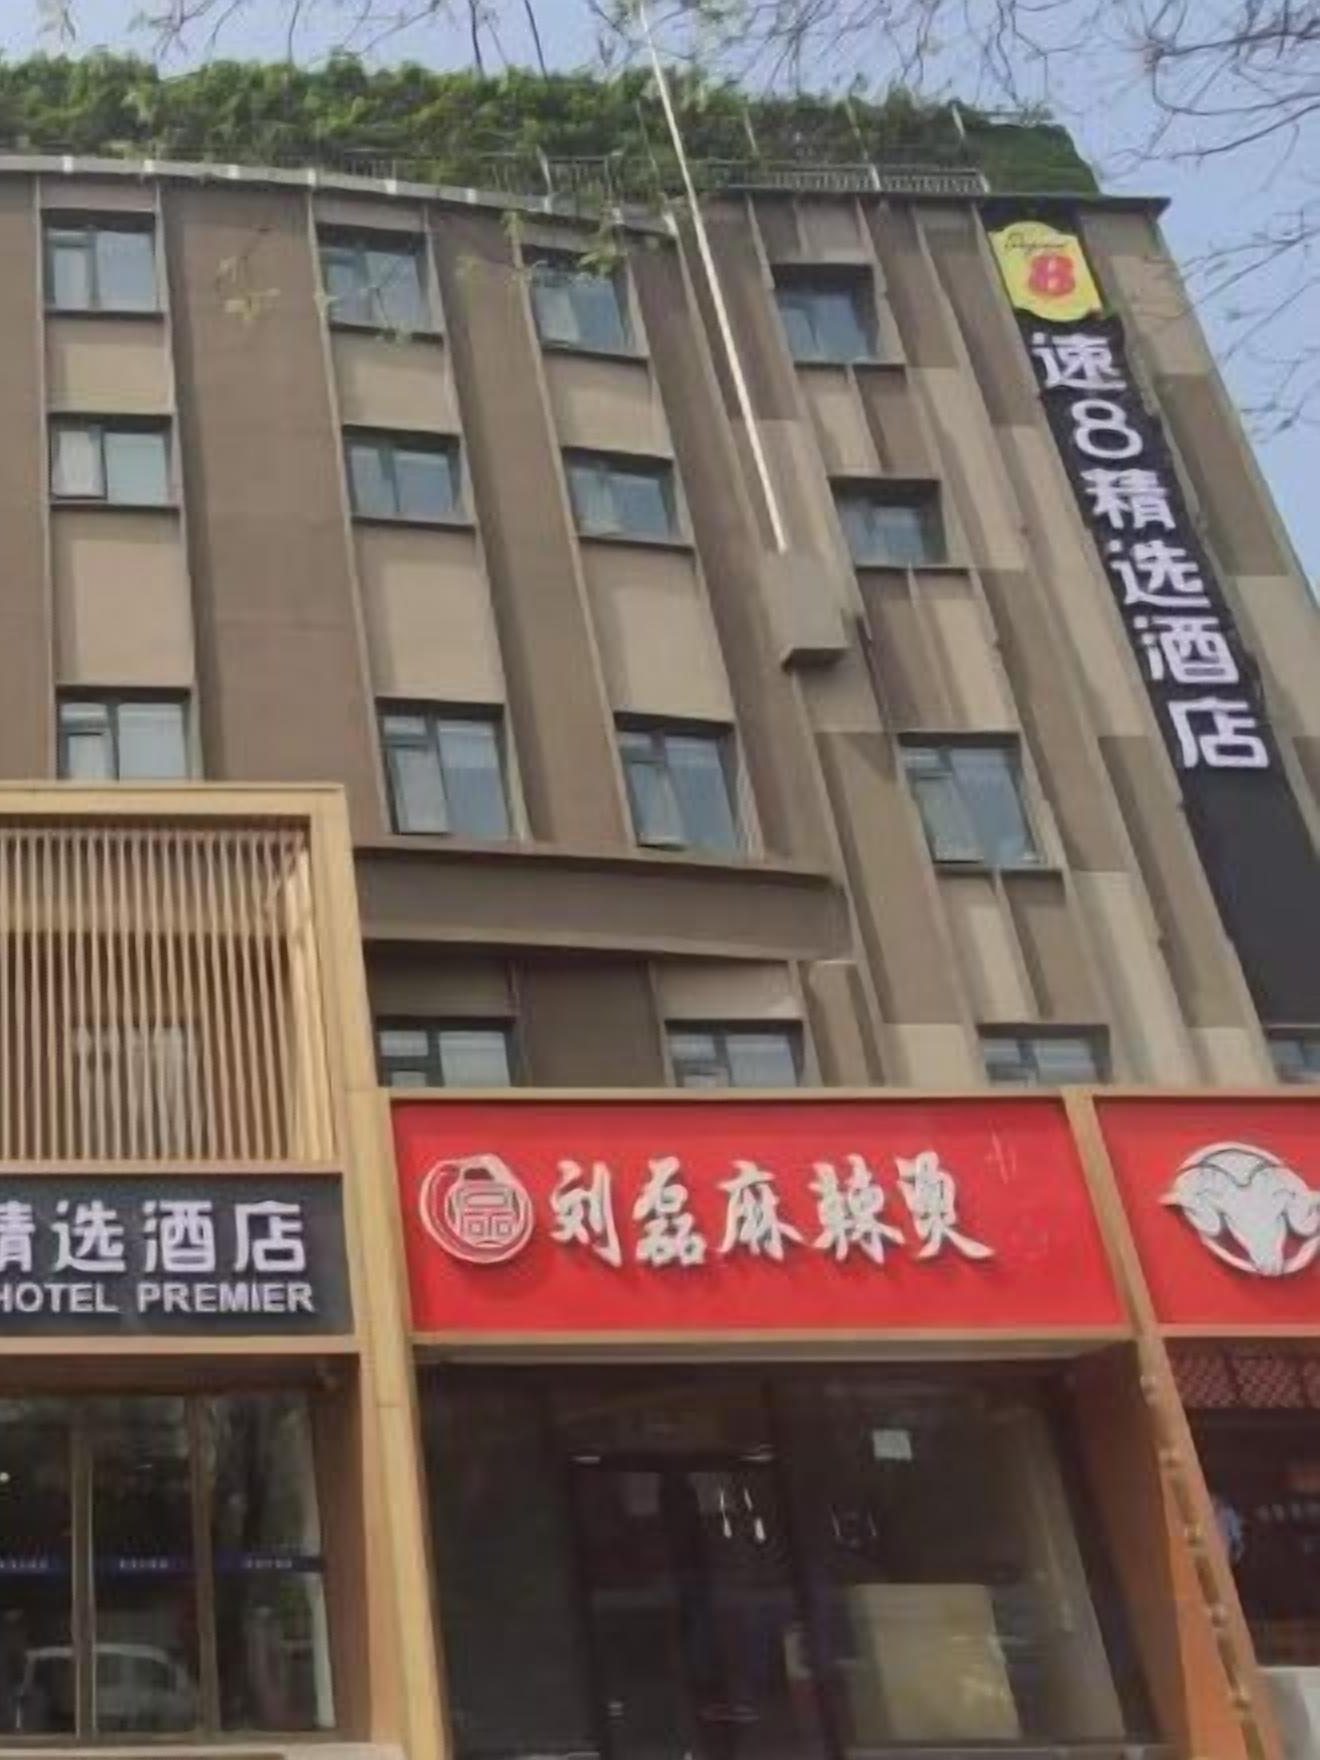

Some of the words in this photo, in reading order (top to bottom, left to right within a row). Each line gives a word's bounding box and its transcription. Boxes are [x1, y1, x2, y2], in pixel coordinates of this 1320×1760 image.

[1028, 254, 1076, 298] 8
[1032, 331, 1269, 768] 速8精选酒店
[550, 1150, 996, 1268] 刘磊麻辣烫
[136, 1281, 317, 1313] PREMIER
